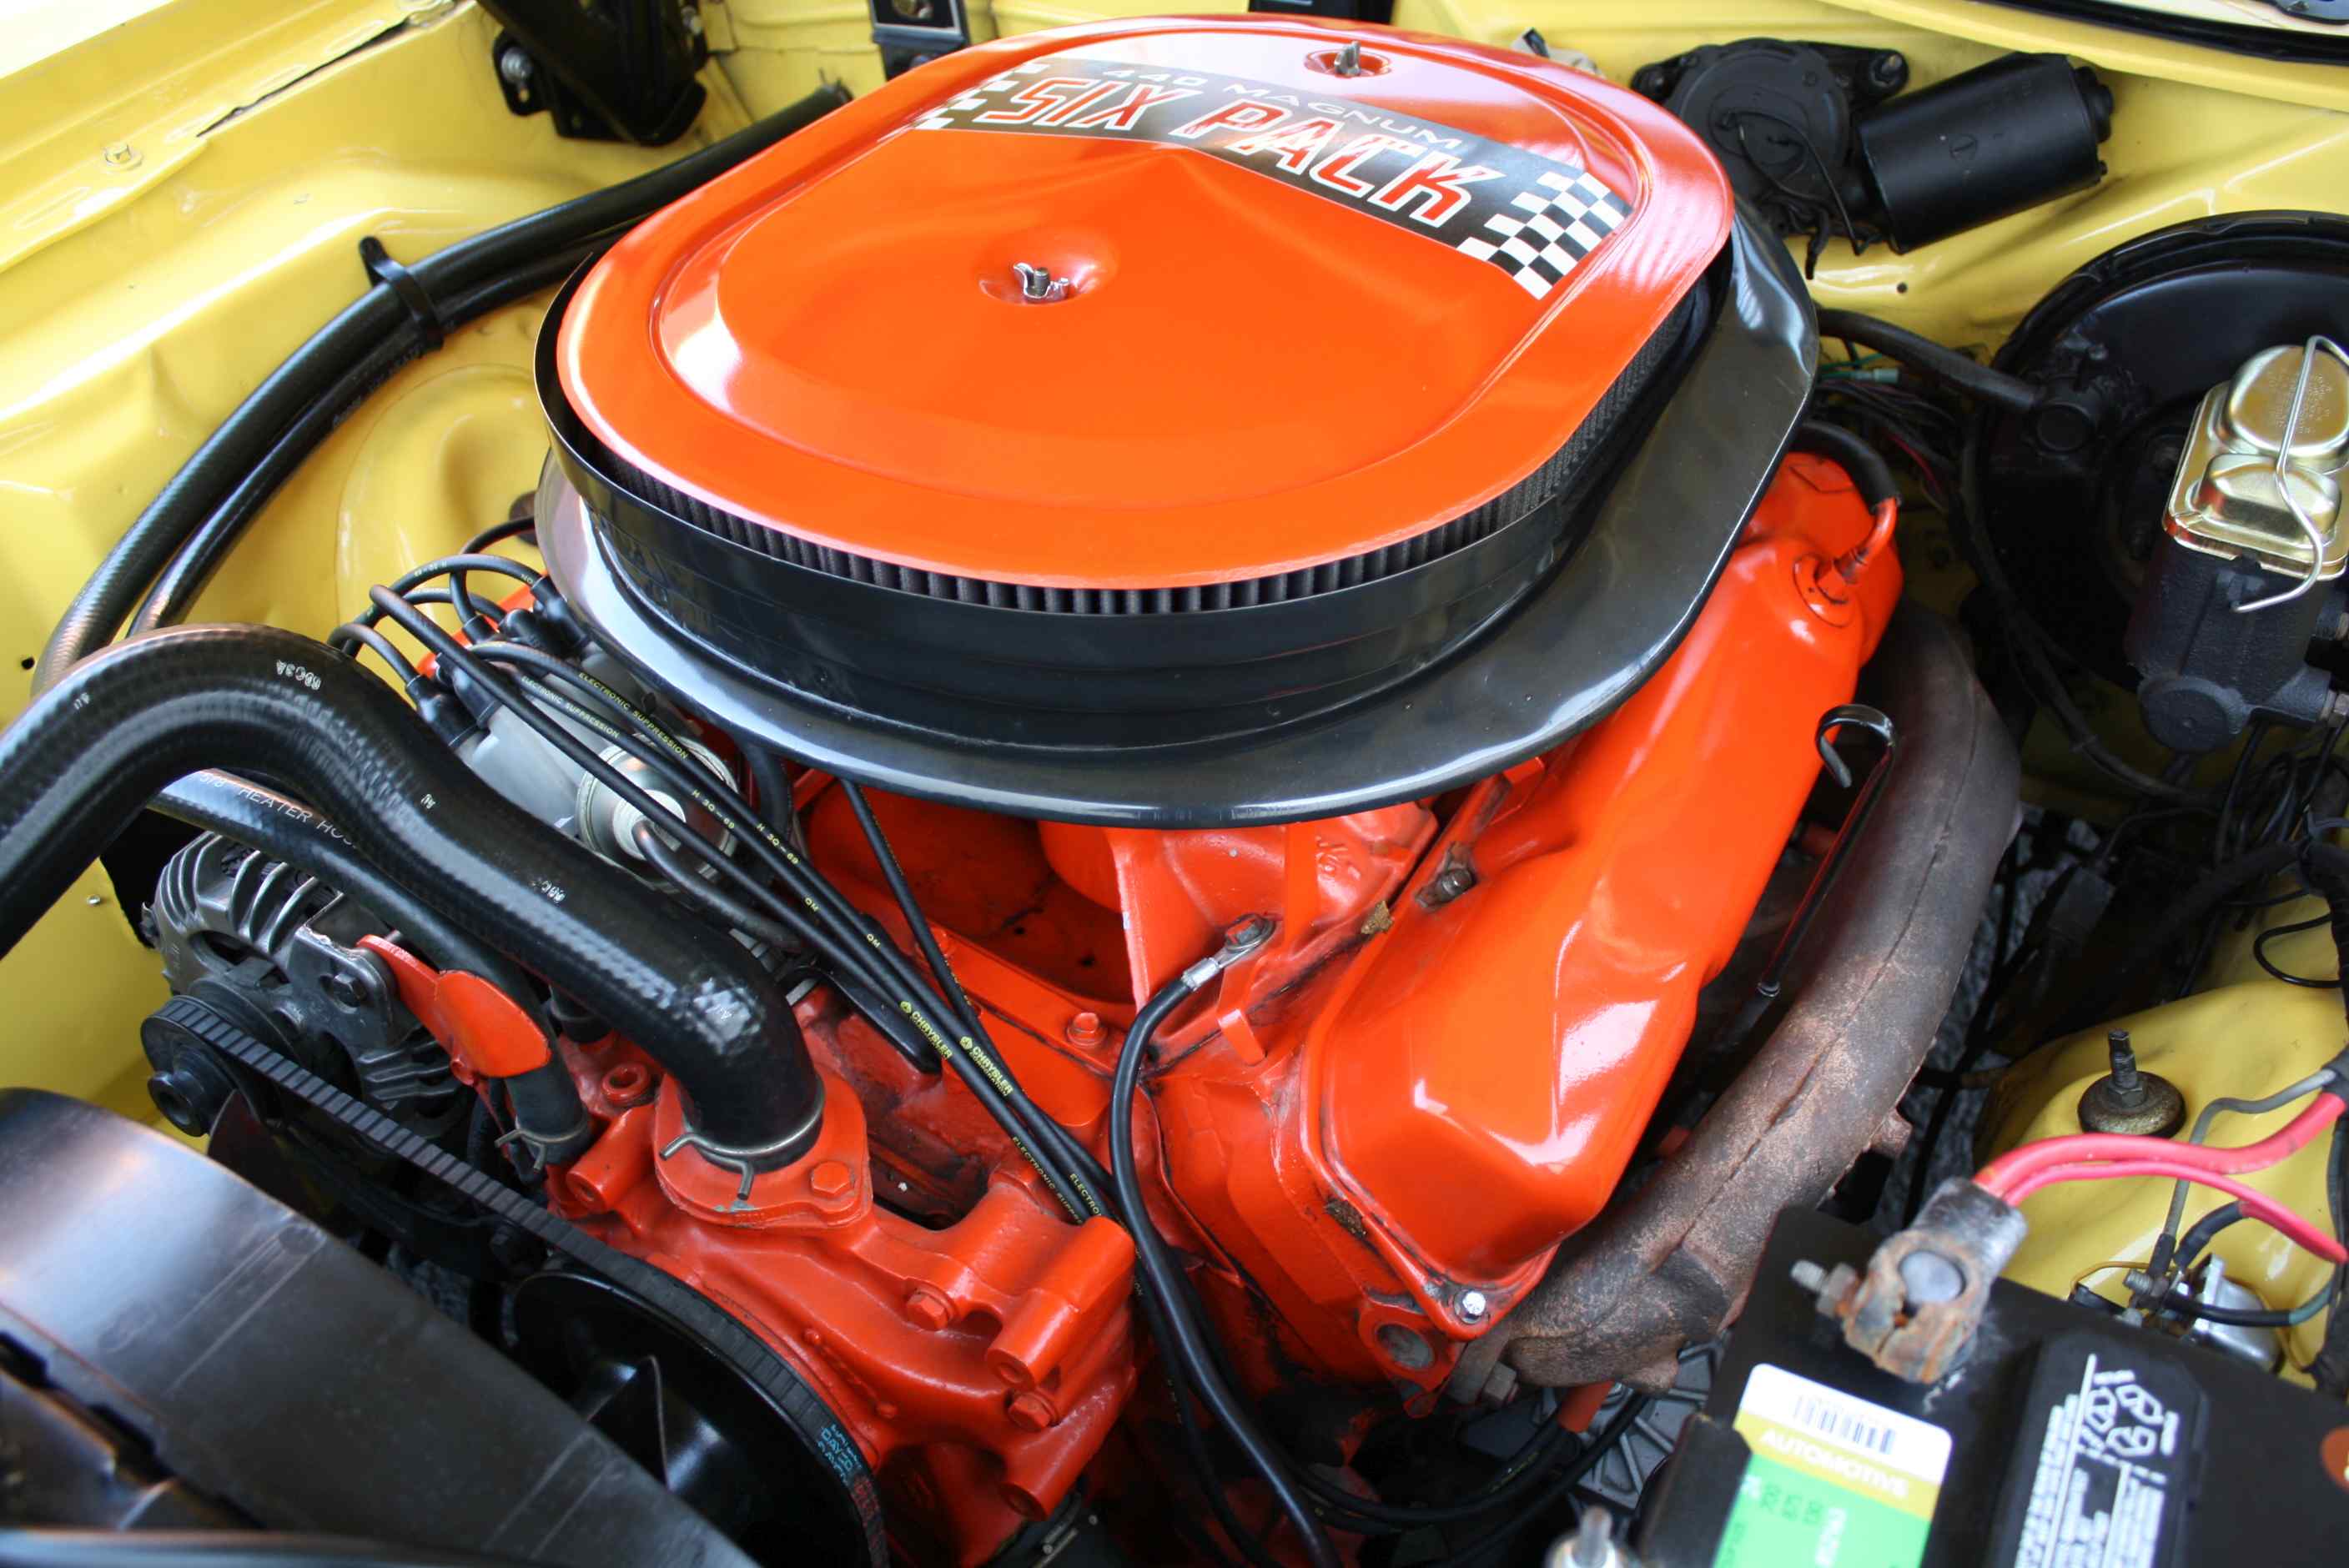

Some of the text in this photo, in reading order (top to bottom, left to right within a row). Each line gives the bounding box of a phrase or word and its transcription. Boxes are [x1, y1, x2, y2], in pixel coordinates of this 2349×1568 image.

[1103, 69, 1463, 151] 440 MAGNUM
[972, 78, 1507, 229] SIX PACK
[521, 675, 621, 739] ELECTRONIC SUPPRESSION
[579, 671, 689, 760] ELECTRONIC SUPPRESSION
[238, 787, 314, 824] HEATER
[911, 1011, 953, 1058] CHRYSLER
[973, 1046, 1014, 1093] CHRYSLER
[1758, 1427, 1911, 1499] AUTOMOTIVE
